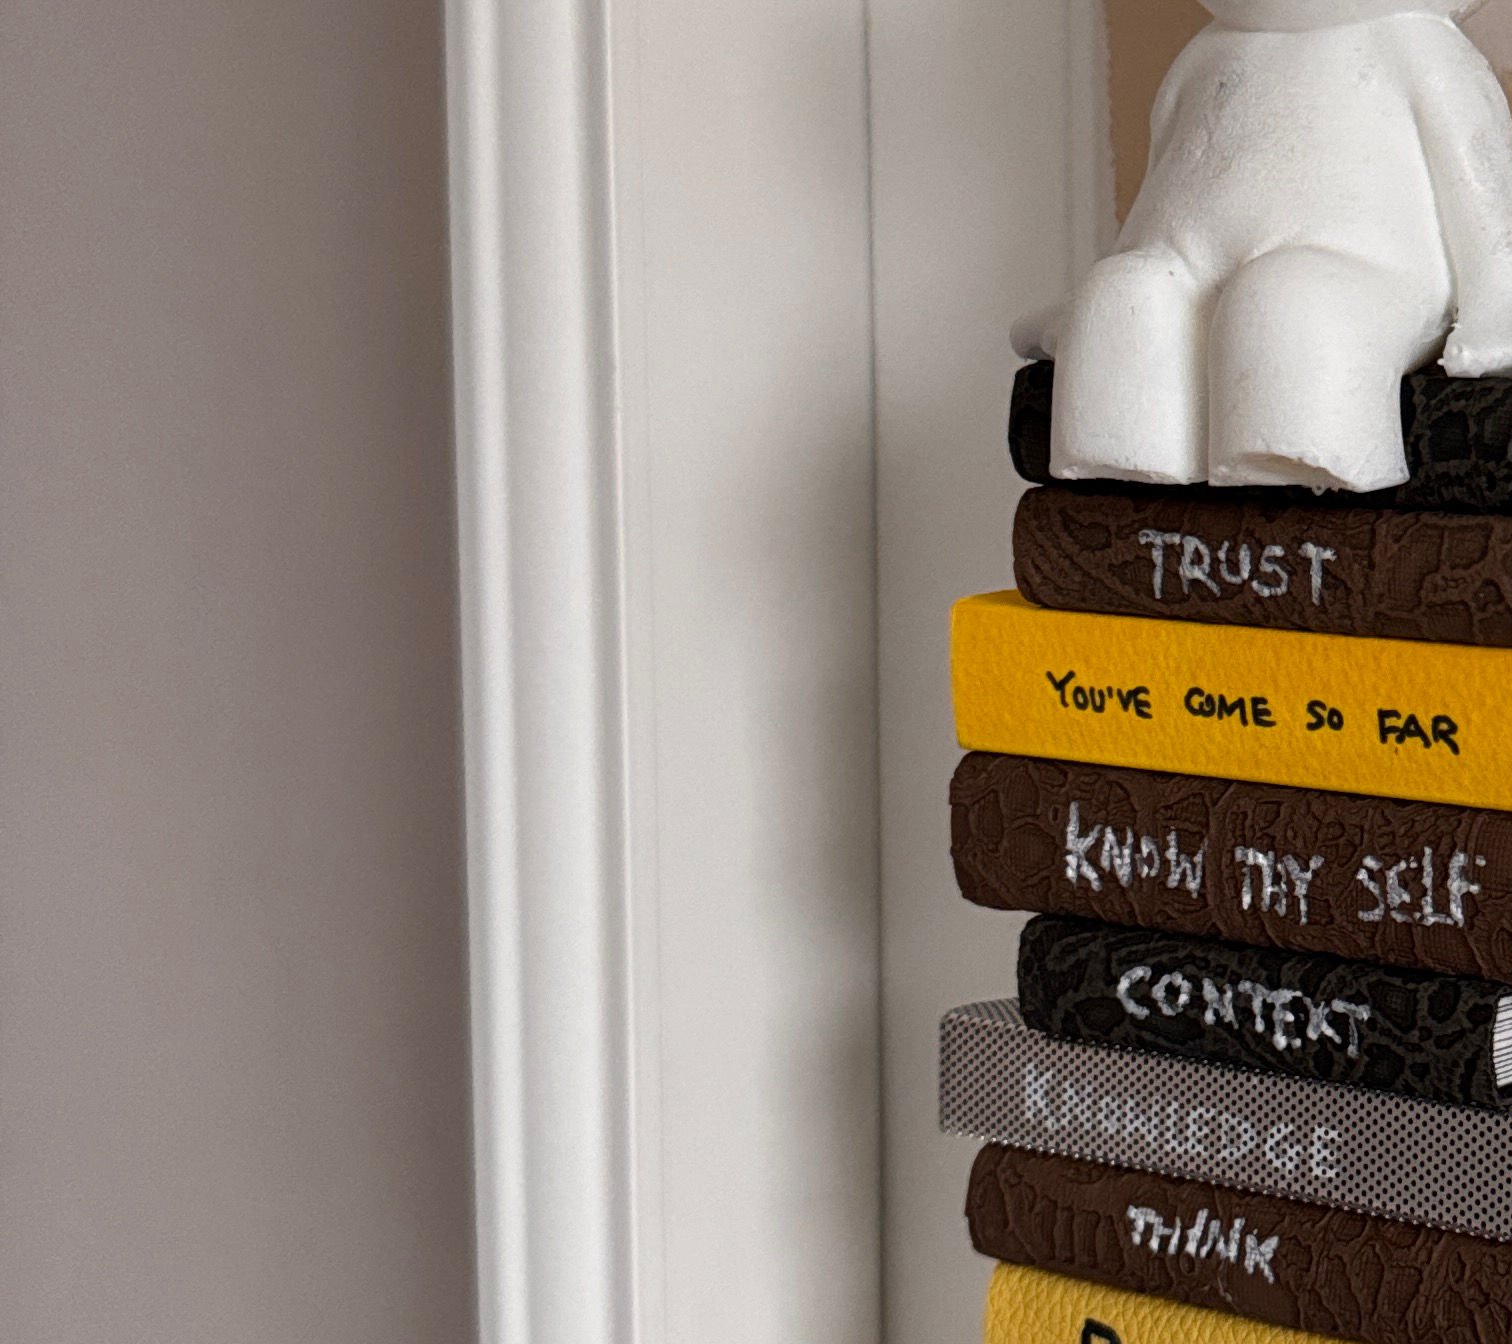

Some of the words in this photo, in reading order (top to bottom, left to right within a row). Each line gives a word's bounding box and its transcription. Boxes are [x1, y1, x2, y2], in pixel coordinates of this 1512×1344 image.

[1140, 530, 1336, 604] TRUST
[1047, 671, 1152, 719] YOU'VE
[1185, 688, 1276, 728] COME
[1307, 700, 1344, 732] SO
[1377, 709, 1460, 755] FAR
[1065, 801, 1204, 896] KNOW
[1235, 845, 1324, 924] THY
[1357, 848, 1486, 926] SELF
[1117, 967, 1371, 1056] CONTEXT
[1128, 1205, 1279, 1283] THINK
